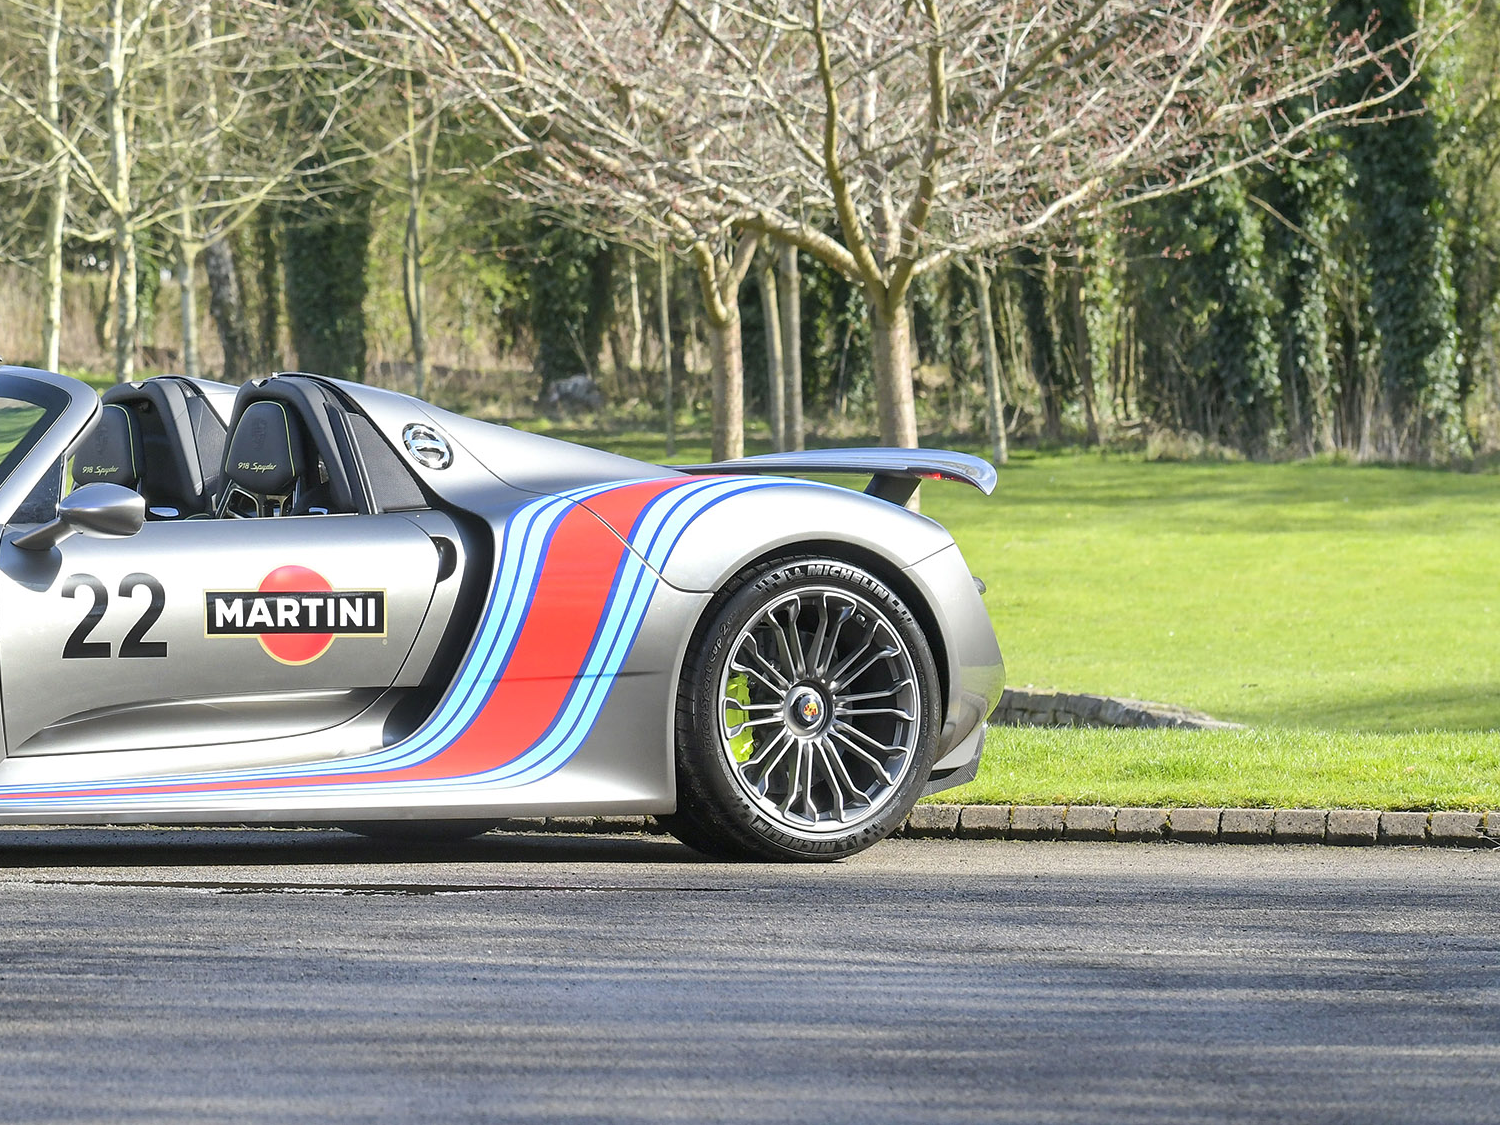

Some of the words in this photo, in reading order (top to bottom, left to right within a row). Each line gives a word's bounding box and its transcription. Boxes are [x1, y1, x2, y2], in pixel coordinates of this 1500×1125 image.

[94, 465, 119, 476] Spyder
[250, 462, 277, 473] Spyder
[806, 564, 889, 600] MICHELIN
[61, 572, 168, 660] 22
[214, 597, 376, 628] MARTINI
[700, 665, 713, 711] Sport
[708, 636, 723, 664] Cup
[719, 622, 730, 636] 2
[751, 819, 836, 853] MICHELIN
